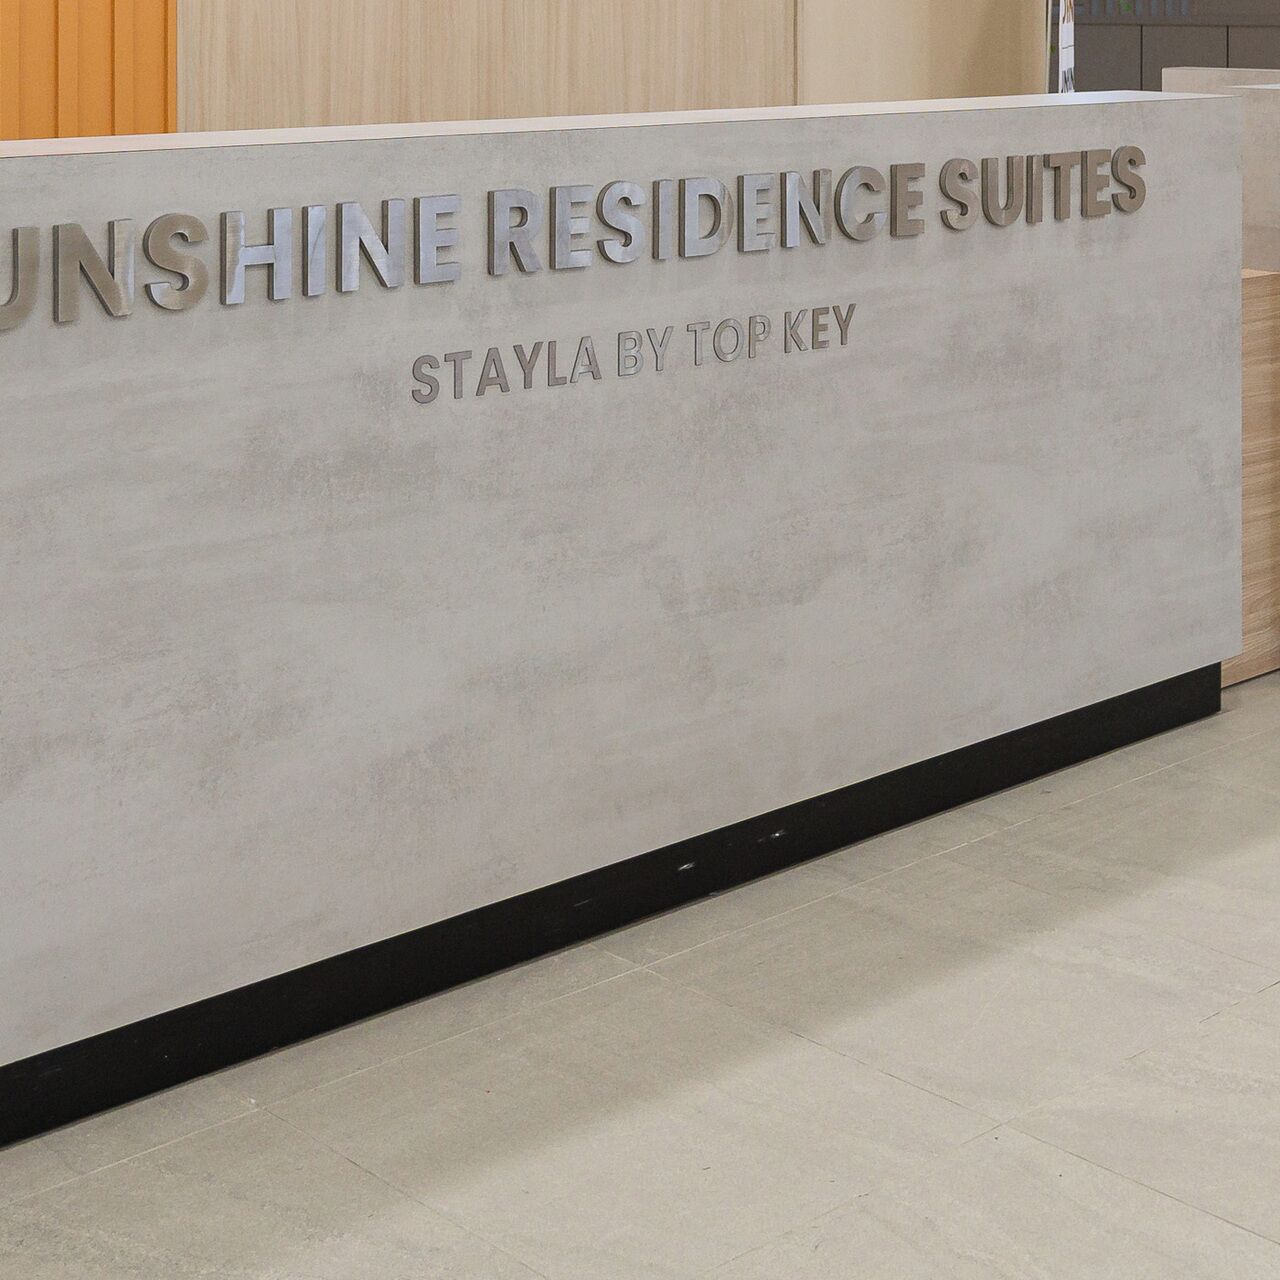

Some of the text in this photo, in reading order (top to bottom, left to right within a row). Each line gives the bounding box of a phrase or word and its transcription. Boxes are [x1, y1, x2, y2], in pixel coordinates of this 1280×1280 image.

[487, 162, 926, 276] RESIDENCE
[939, 145, 1147, 231] SUITES
[411, 303, 857, 404] STAYLA BY TOP KEY
